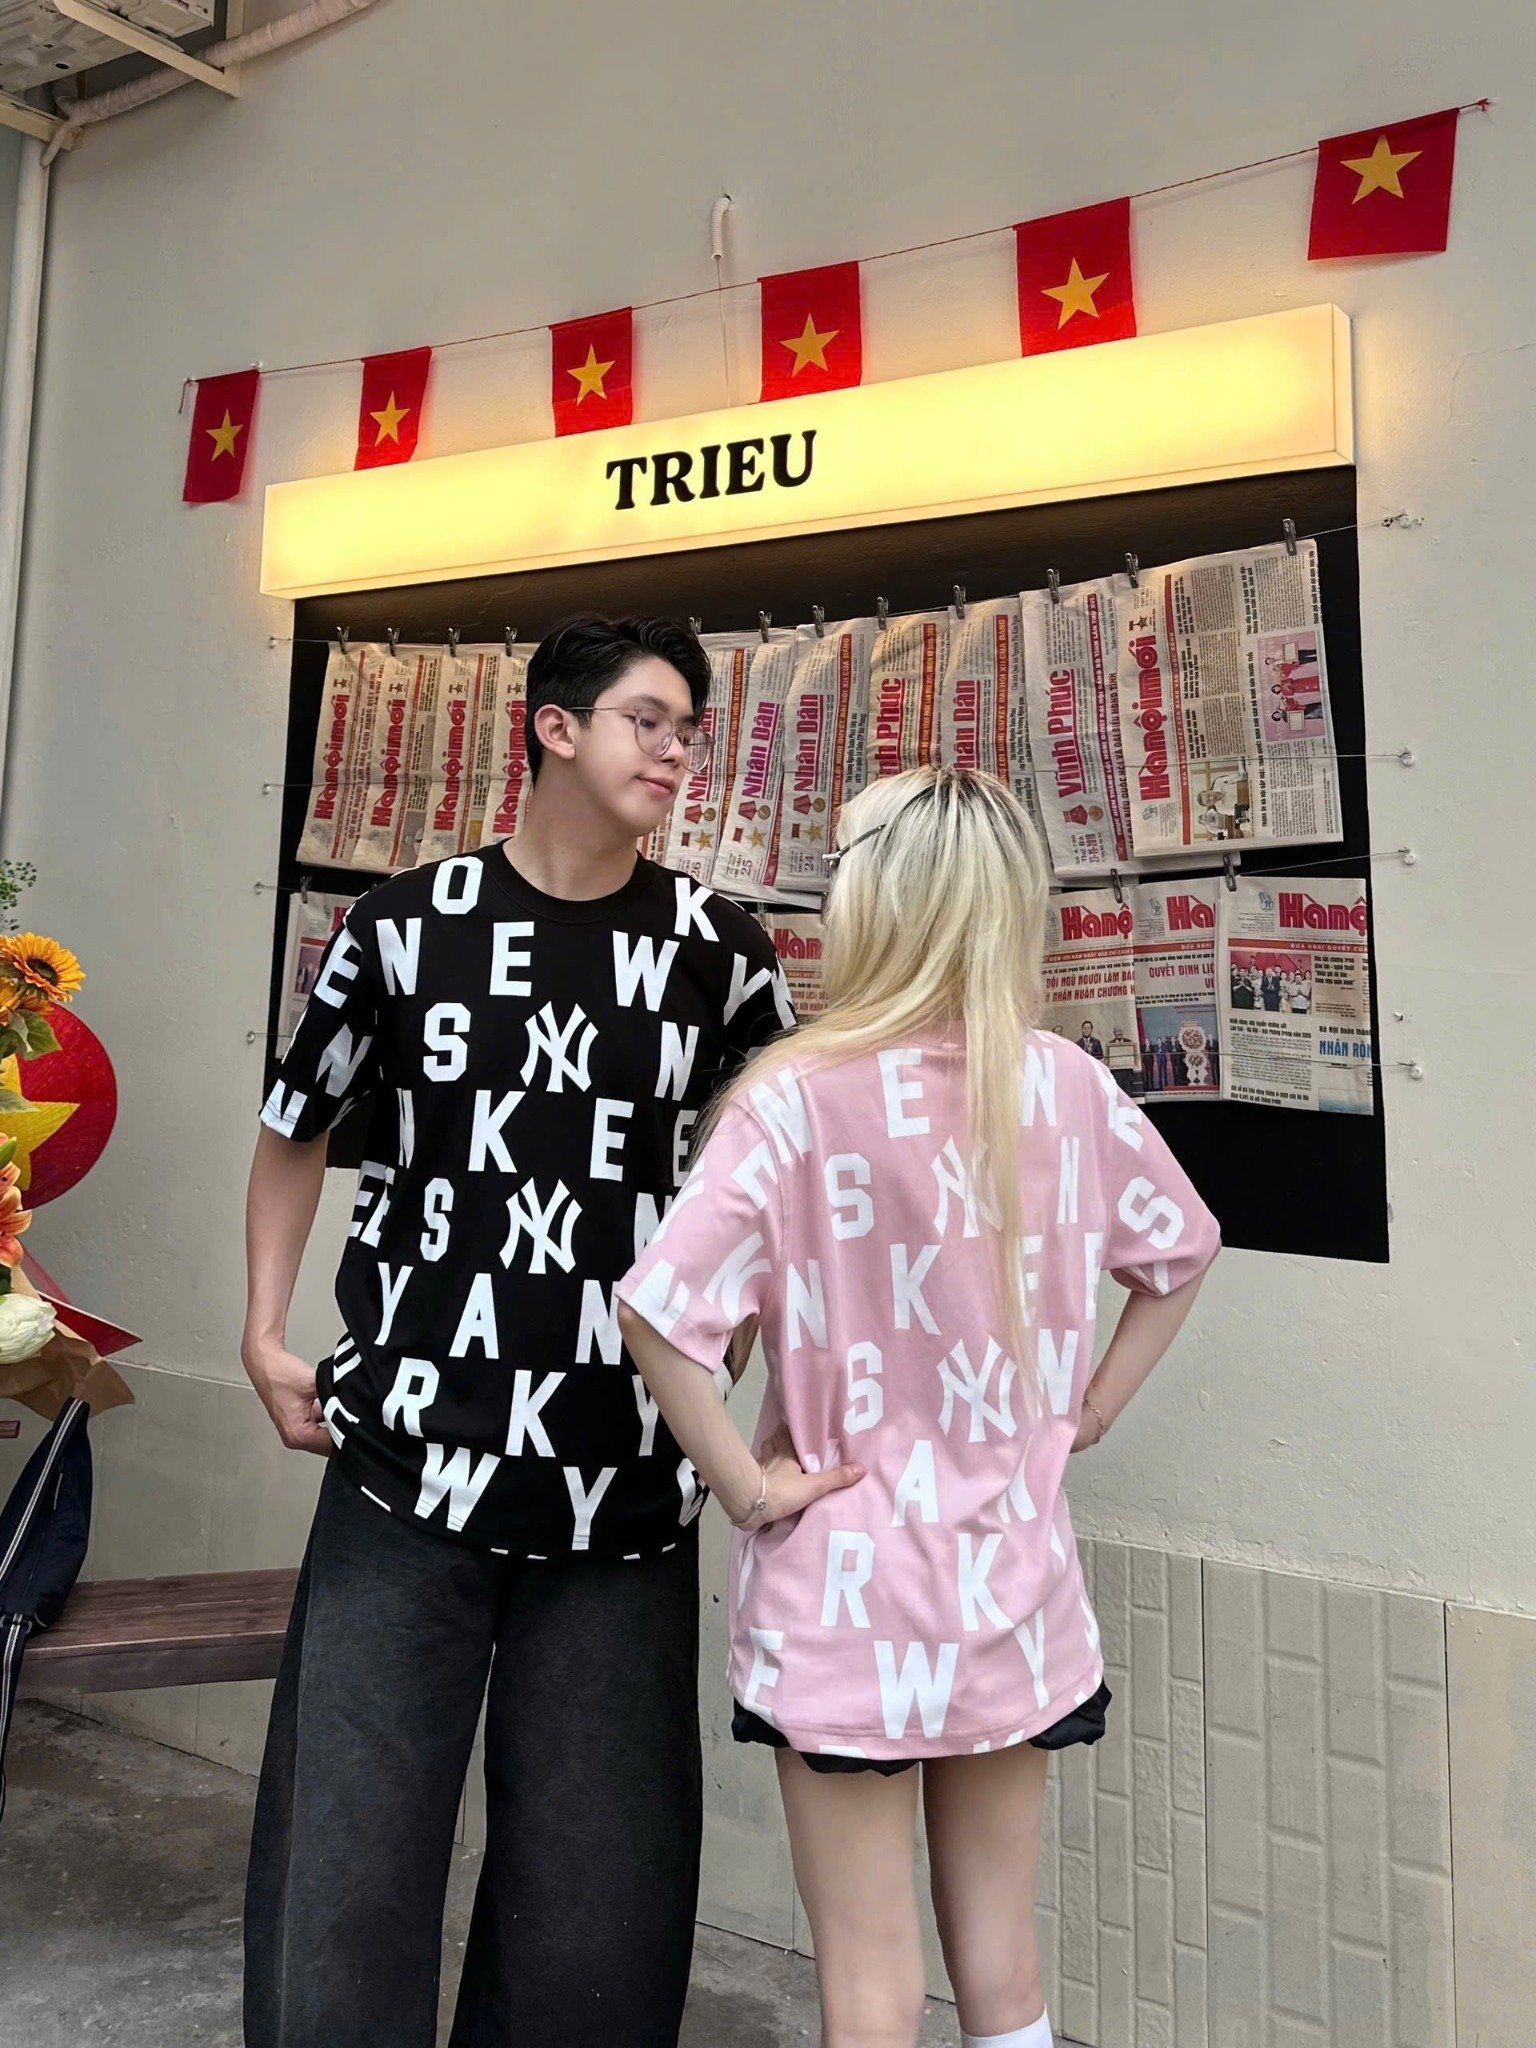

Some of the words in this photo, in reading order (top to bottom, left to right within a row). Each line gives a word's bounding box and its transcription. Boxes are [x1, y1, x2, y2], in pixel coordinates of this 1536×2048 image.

[606, 429, 817, 510] TRIEU
[751, 702, 776, 741] Dân
[797, 694, 819, 733] Dân
[876, 678, 901, 739] Phúc
[952, 680, 975, 721] Dân
[1045, 669, 1073, 735] Phúc
[742, 746, 766, 798] Nhân
[794, 739, 817, 792] Nhân
[1052, 739, 1083, 797] Vĩnh
[432, 856, 483, 916] O
[674, 877, 719, 942] K
[375, 917, 422, 996] N
[489, 921, 535, 996] E
[612, 930, 680, 1012] W
[422, 1002, 472, 1082] S
[520, 1000, 599, 1093] NY
[655, 1021, 699, 1101] N
[877, 1048, 930, 1139] E
[1020, 1045, 1057, 1127] N
[468, 1089, 526, 1173] K
[590, 1097, 635, 1181] E
[420, 1177, 454, 1262] S
[500, 1177, 582, 1275] NY
[823, 1152, 874, 1241] S
[1117, 1176, 1185, 1250] S
[374, 1262, 413, 1345] Y
[449, 1273, 499, 1359] A
[575, 1279, 622, 1365] N
[787, 1258, 828, 1352] N
[889, 1244, 941, 1336] K
[382, 1357, 440, 1437] R
[505, 1370, 567, 1457] K
[843, 1341, 883, 1435] S
[936, 1336, 1017, 1443] NY
[413, 1443, 501, 1532] W
[563, 1467, 618, 1551] Y
[891, 1439, 940, 1528] A
[820, 1530, 876, 1629] R
[957, 1532, 1015, 1632] K
[873, 1640, 960, 1740] W
